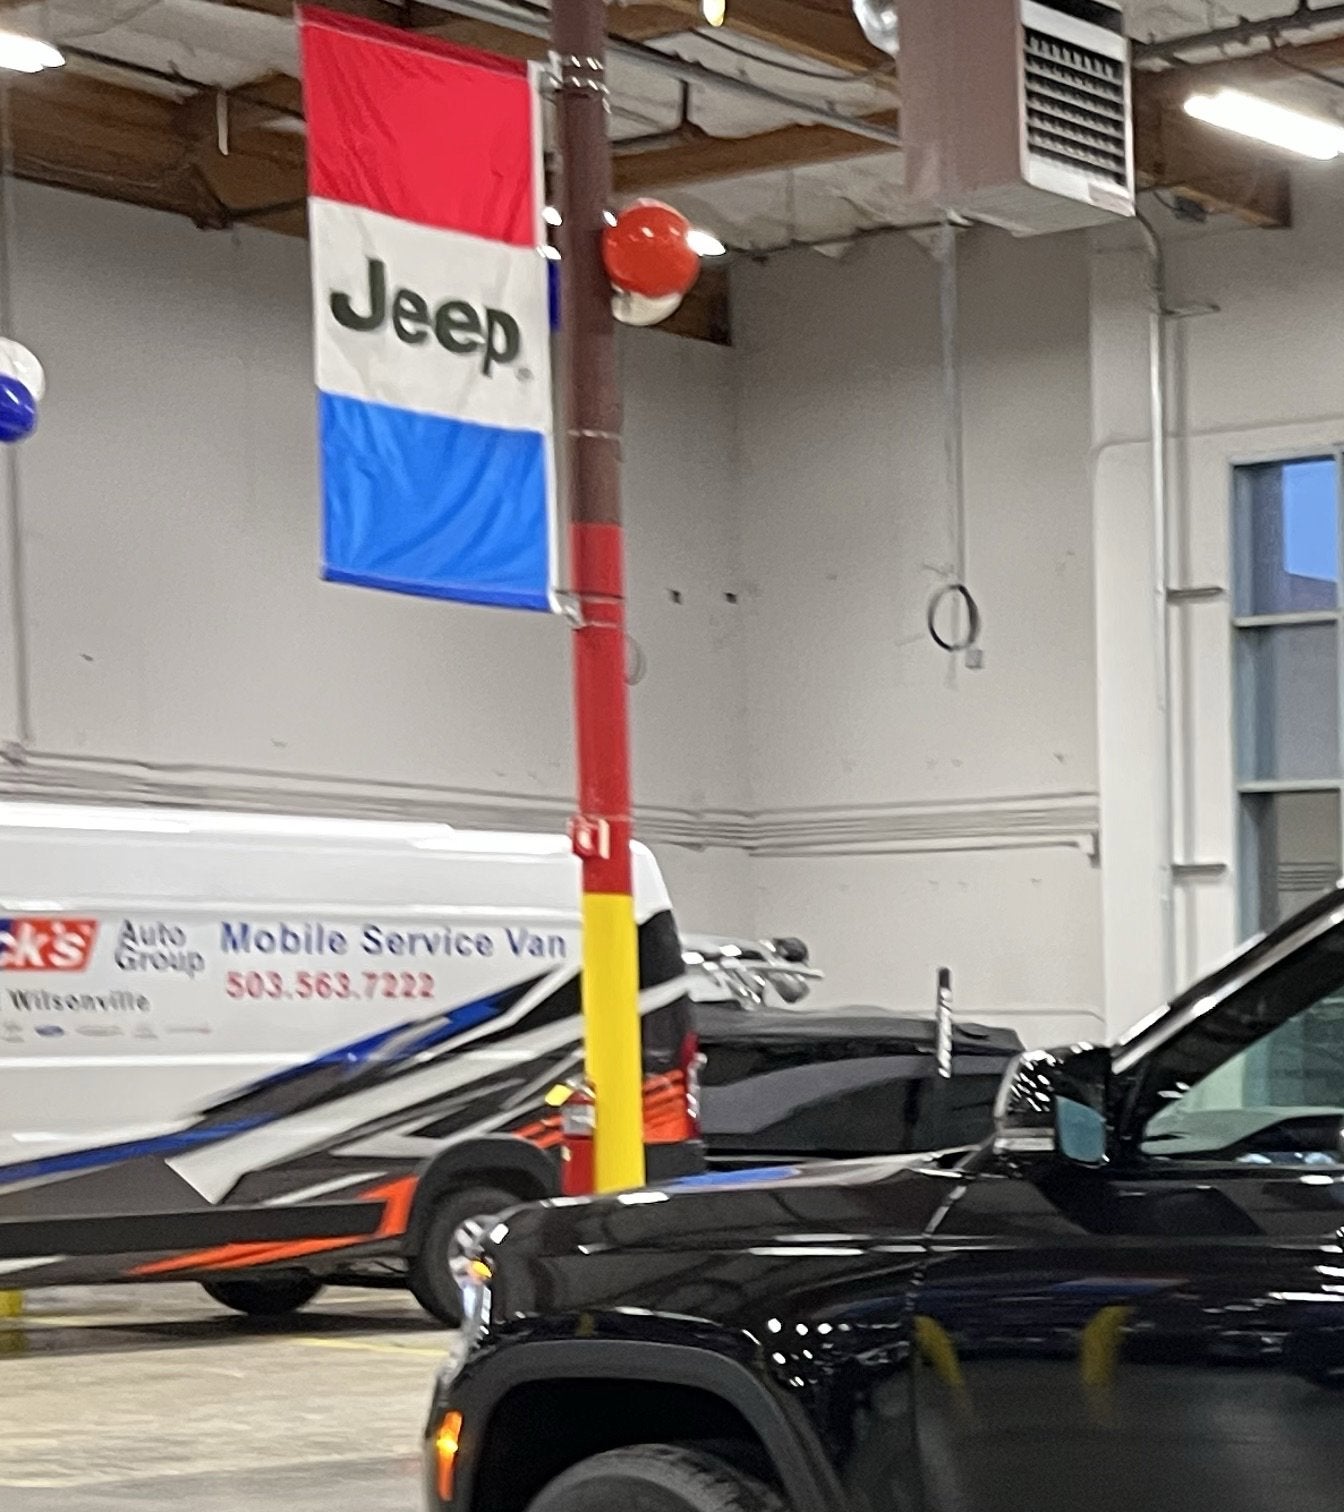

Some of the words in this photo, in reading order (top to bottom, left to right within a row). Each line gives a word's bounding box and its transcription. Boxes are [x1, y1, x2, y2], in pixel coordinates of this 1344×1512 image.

[329, 257, 520, 378] Jeep
[117, 918, 187, 949] Auto
[220, 921, 347, 955] Mobile
[361, 923, 494, 957] Service
[503, 926, 566, 959] Van
[114, 947, 205, 980] Group
[7, 987, 150, 1011] Wilsonville
[226, 970, 435, 1000] 503.563.7222
